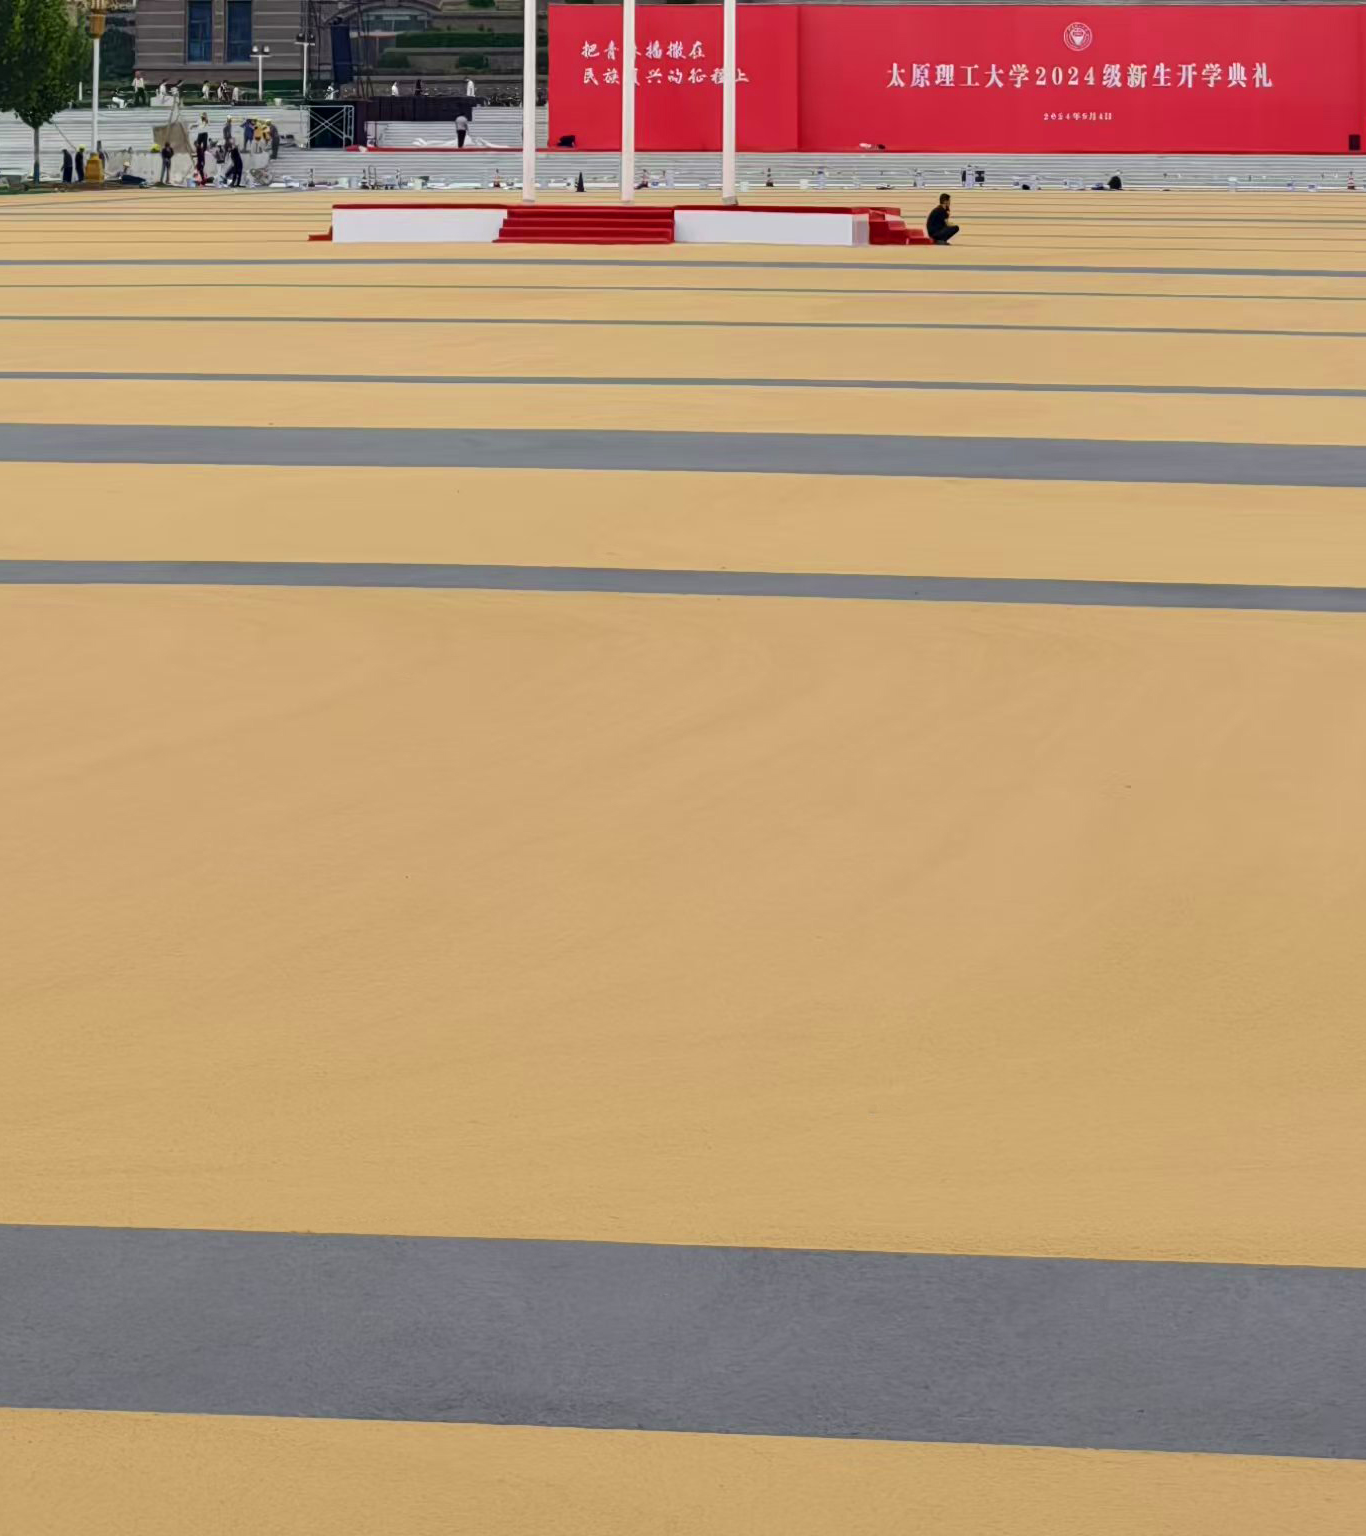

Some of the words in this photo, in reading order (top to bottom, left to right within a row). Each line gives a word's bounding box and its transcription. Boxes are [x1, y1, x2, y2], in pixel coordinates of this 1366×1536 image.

[581, 39, 706, 61] 把青播撒在
[886, 62, 1274, 89] 太原理工大学2024级新生开学典礼
